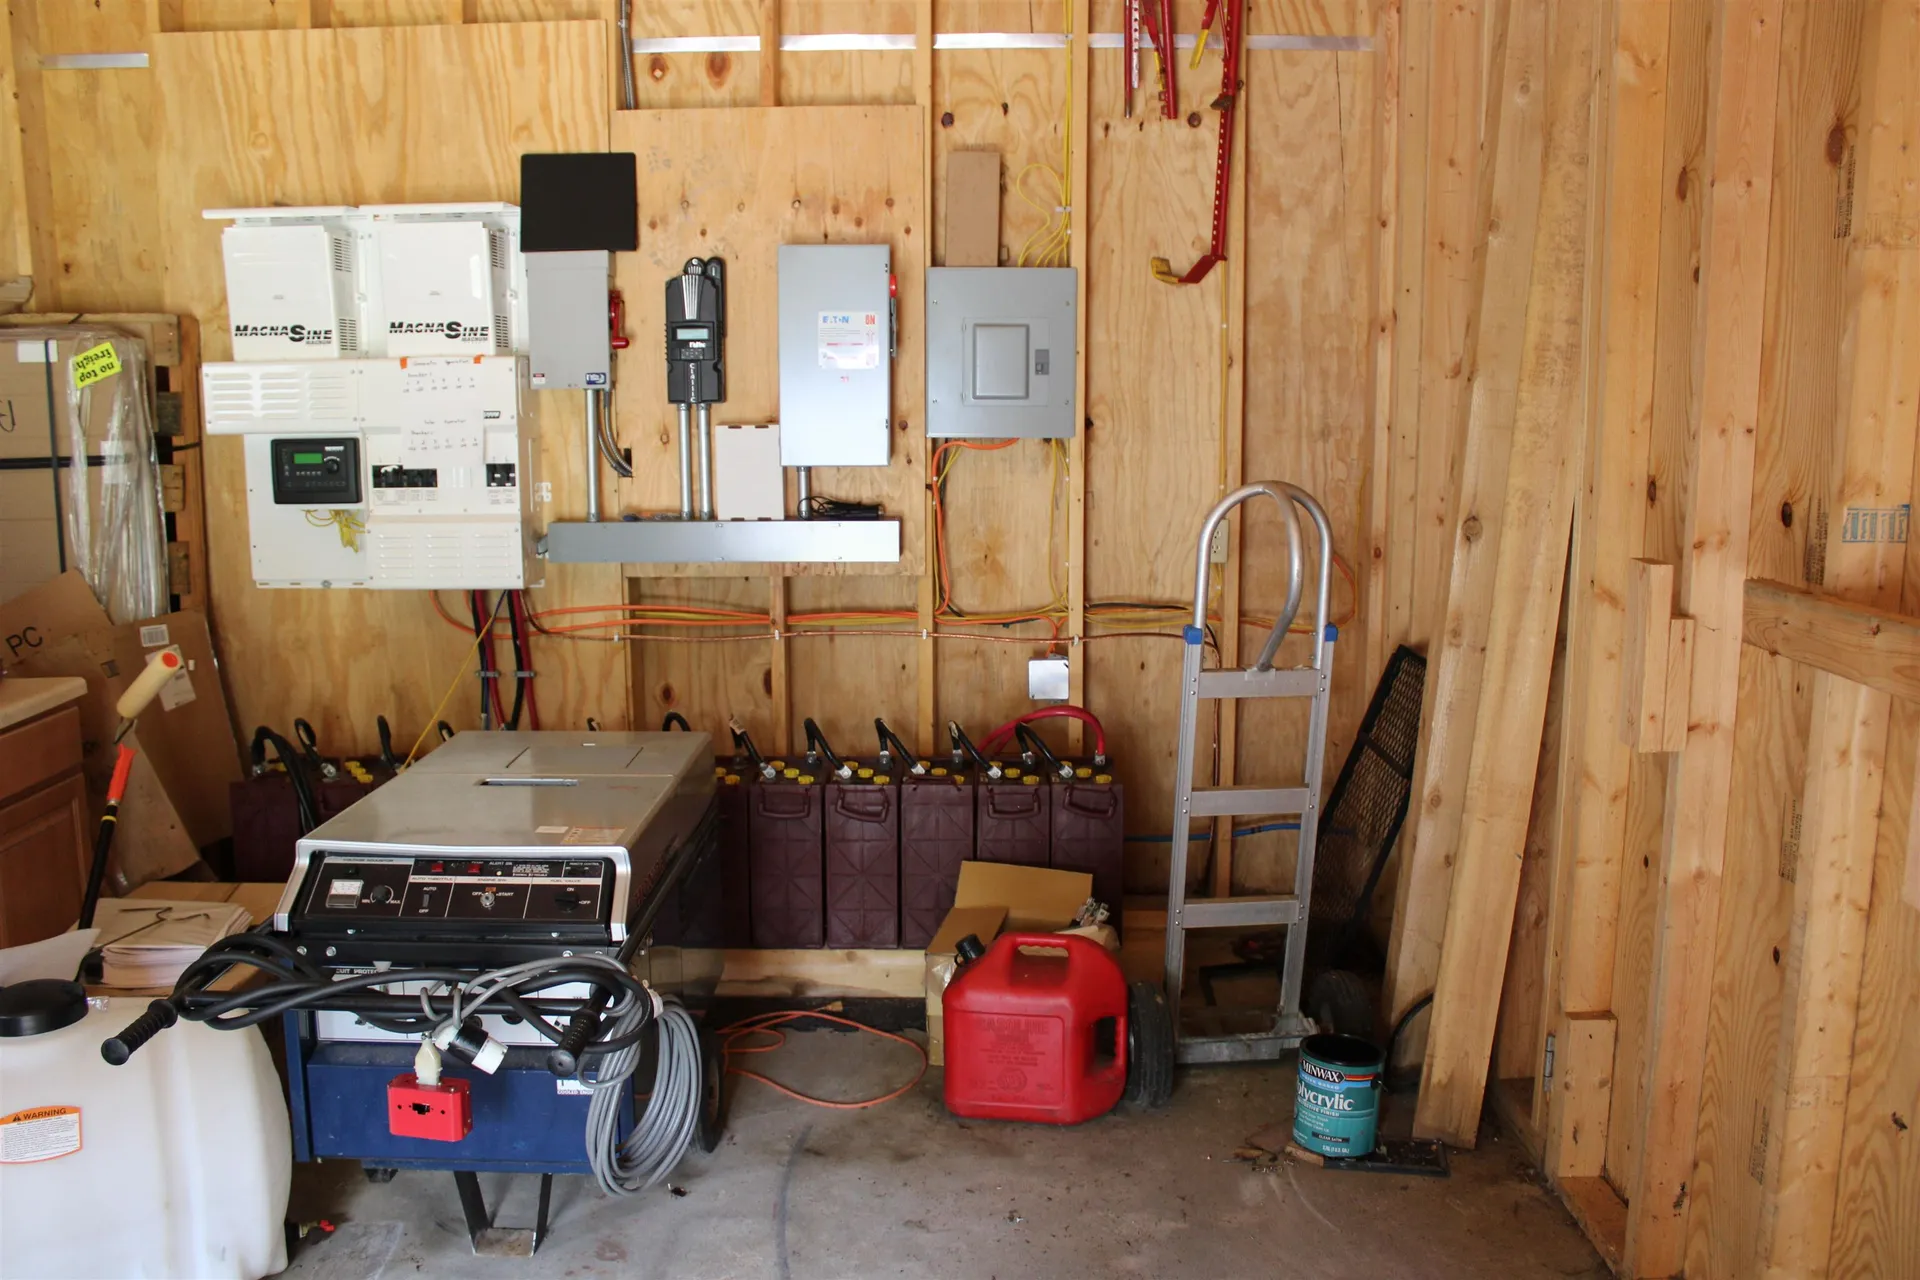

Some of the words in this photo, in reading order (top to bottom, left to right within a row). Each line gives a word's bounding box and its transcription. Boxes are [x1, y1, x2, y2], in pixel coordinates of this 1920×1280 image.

[100, 362, 114, 372] no
[79, 370, 98, 382] top
[5, 626, 43, 657] PC
[1302, 1060, 1340, 1083] MINWAX
[23, 1107, 67, 1120] WARNING
